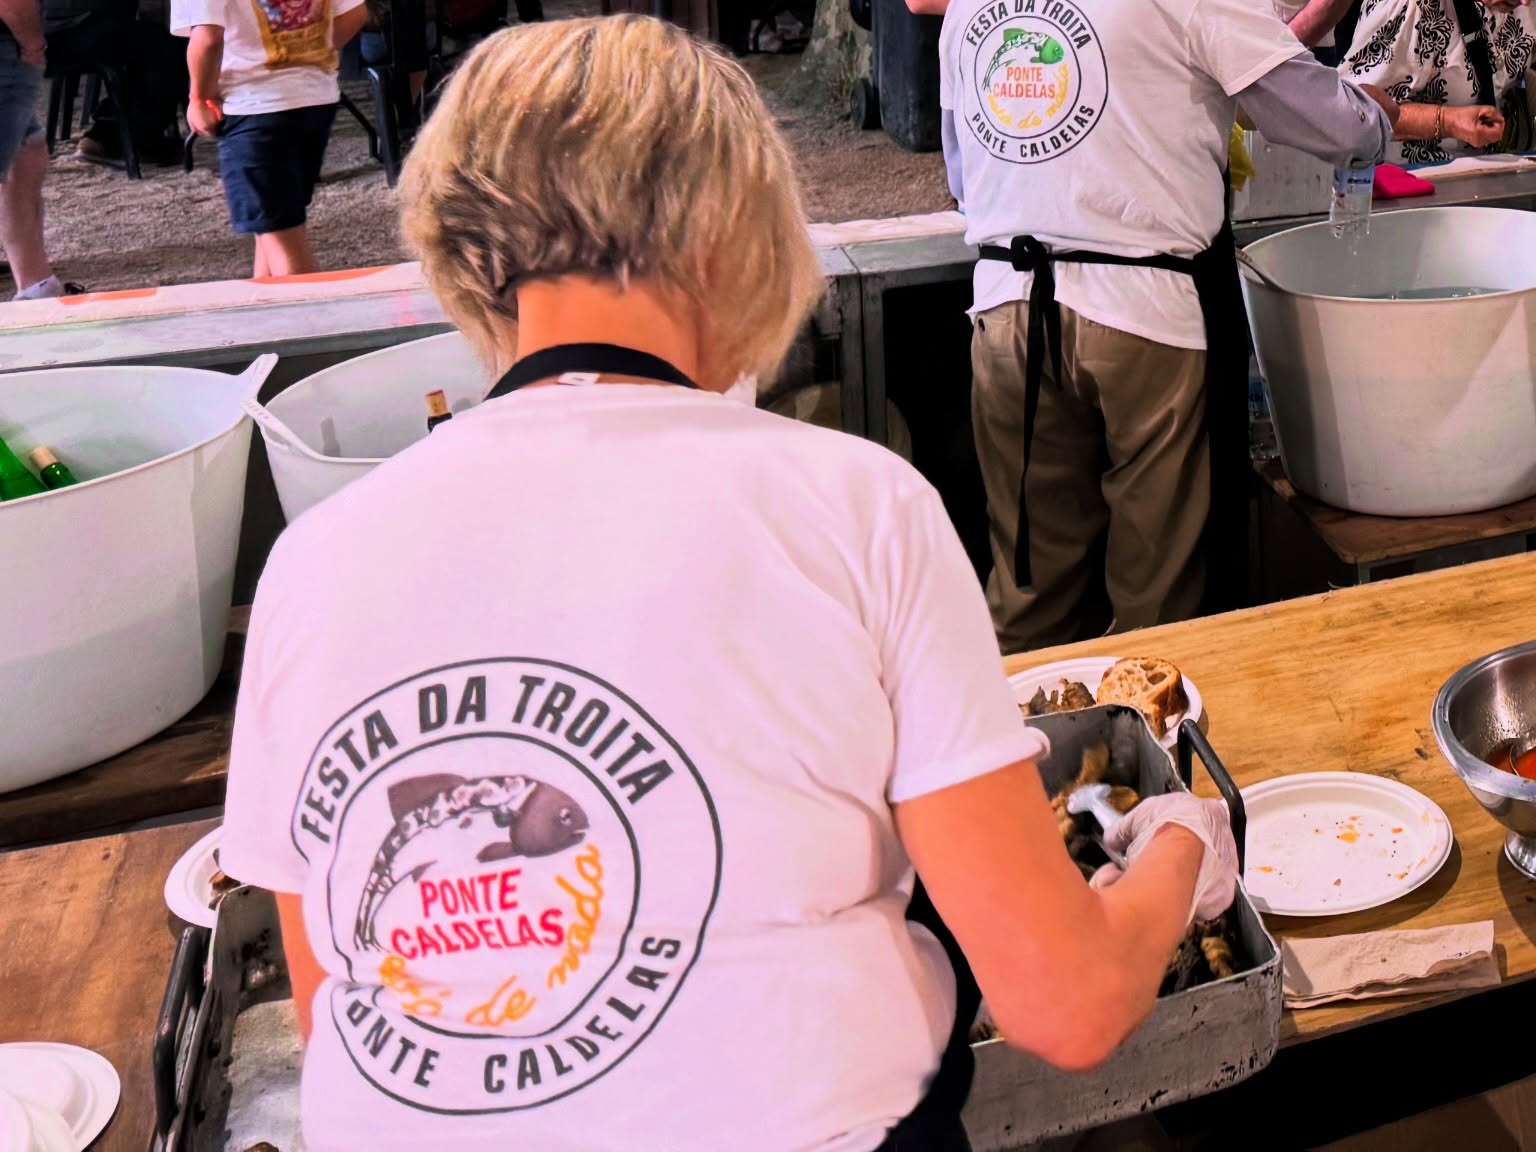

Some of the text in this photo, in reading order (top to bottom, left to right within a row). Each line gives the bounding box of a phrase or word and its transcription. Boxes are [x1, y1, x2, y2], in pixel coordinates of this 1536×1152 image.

[966, 2, 1008, 46] FESTA
[993, 83, 1055, 98] CALDELAS
[1006, 66, 1043, 82] PONTE
[972, 105, 1094, 158] PONTE CALDELAS
[302, 675, 674, 843] FESTA DA TROITA
[420, 868, 522, 918] PONTE
[391, 908, 565, 960] CALDELAS
[345, 936, 681, 1093] ONTE CALDELAS
[465, 975, 536, 1027] de
